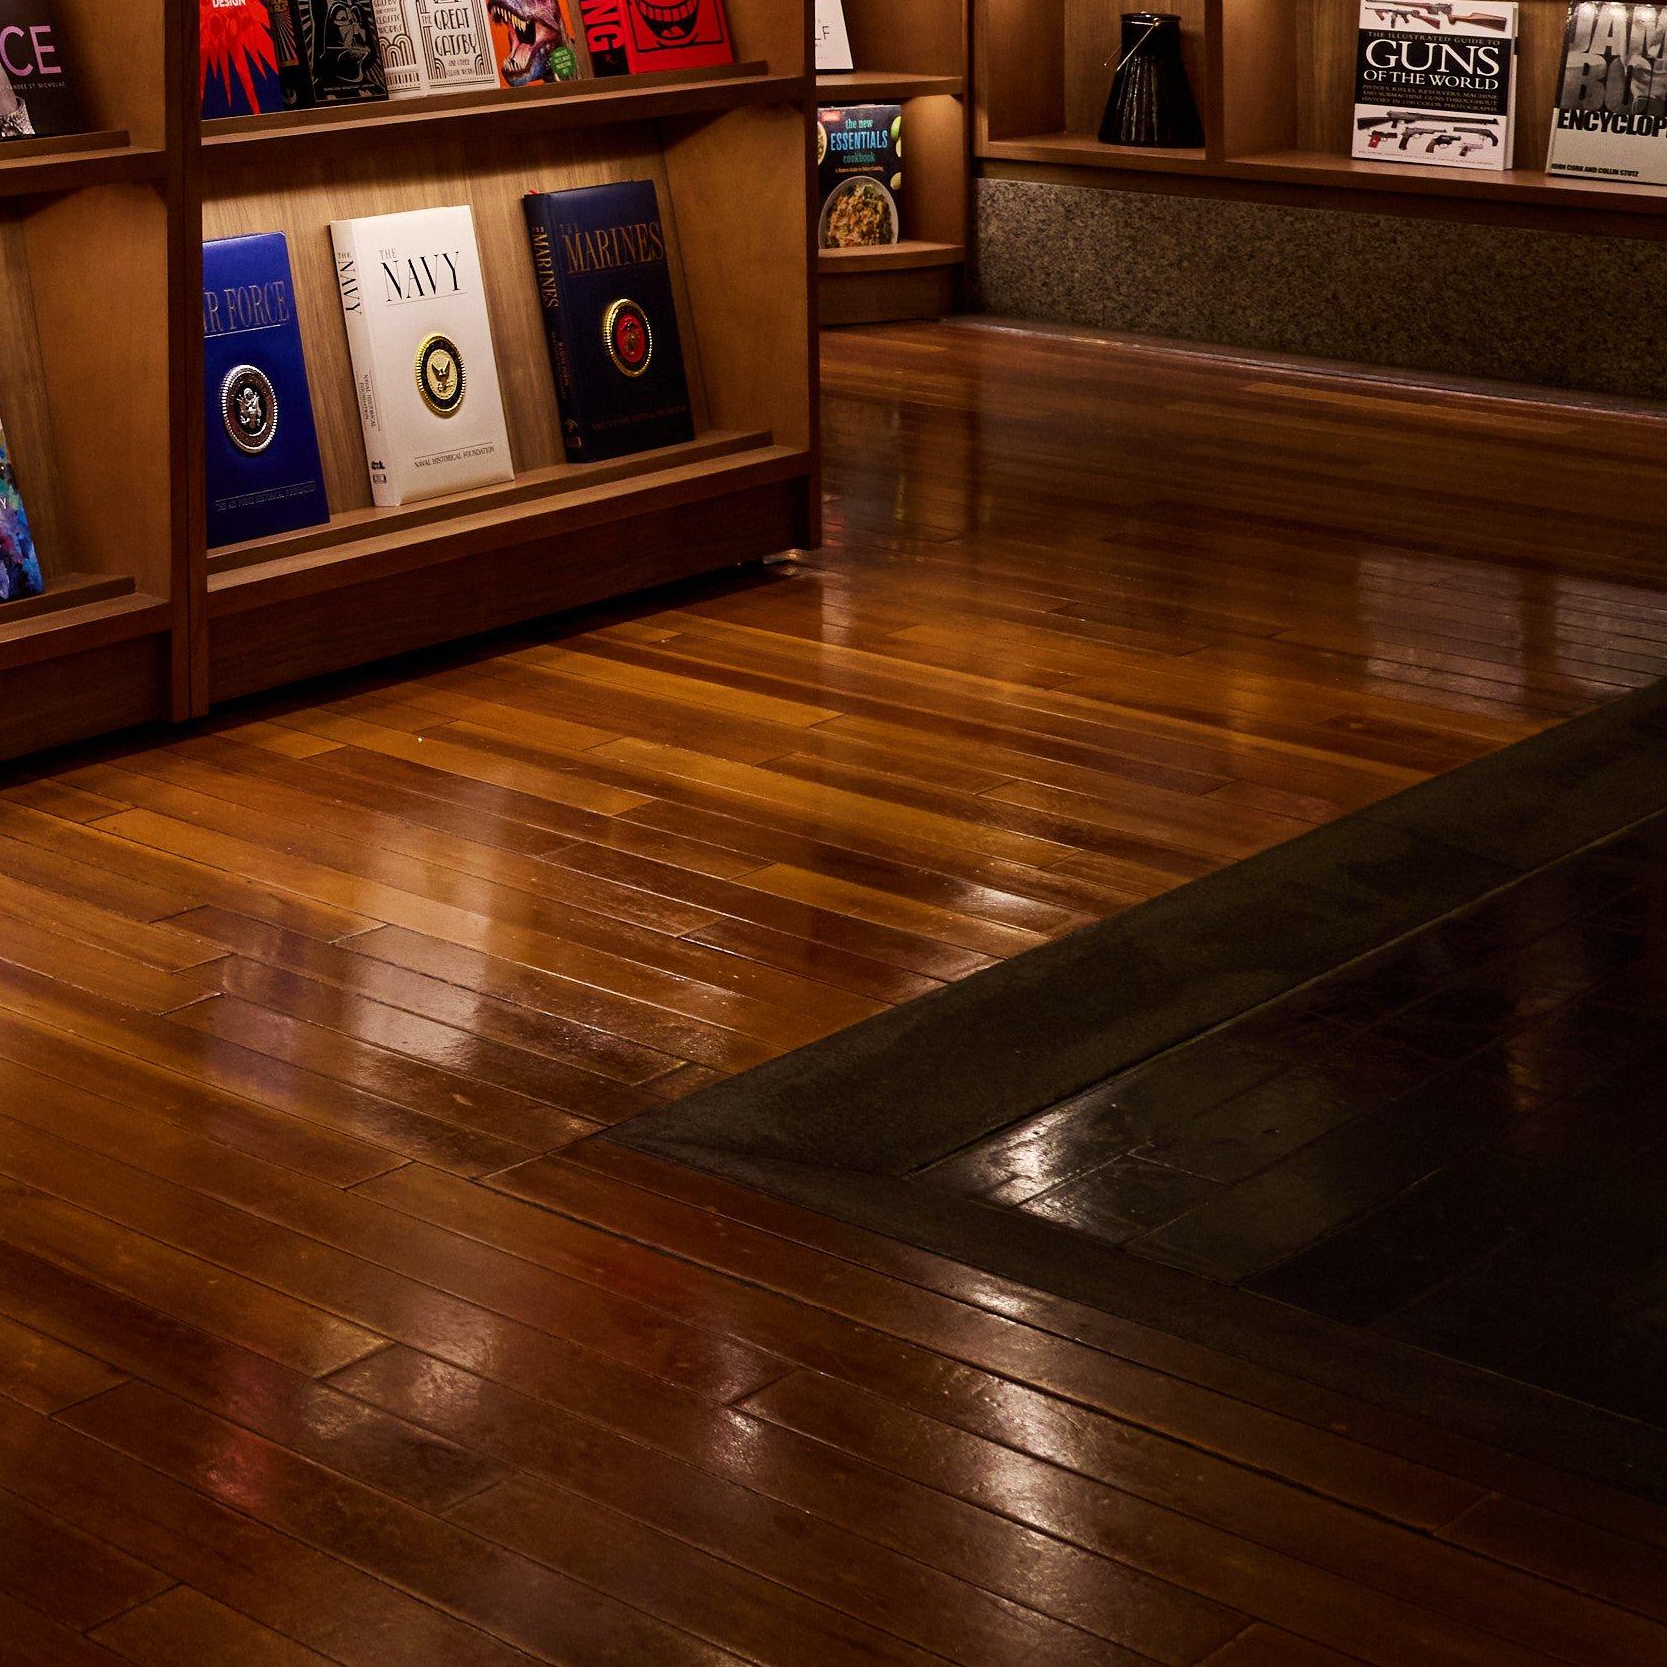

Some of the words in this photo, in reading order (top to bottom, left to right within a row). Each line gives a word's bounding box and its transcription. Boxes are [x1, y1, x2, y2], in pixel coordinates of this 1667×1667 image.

[434, 8, 470, 30] GREAT
[1365, 38, 1500, 77] GUNS
[1363, 69, 1387, 82] OF
[1388, 71, 1425, 85] THE
[1429, 74, 1499, 90] WORLD
[858, 119, 874, 128] new
[830, 129, 888, 151] ESSENTIALS
[379, 248, 396, 260] THE
[563, 220, 665, 272] MARINES
[338, 261, 363, 315] NAVY
[381, 251, 461, 302] NAVY
[224, 281, 290, 330] FORCE
